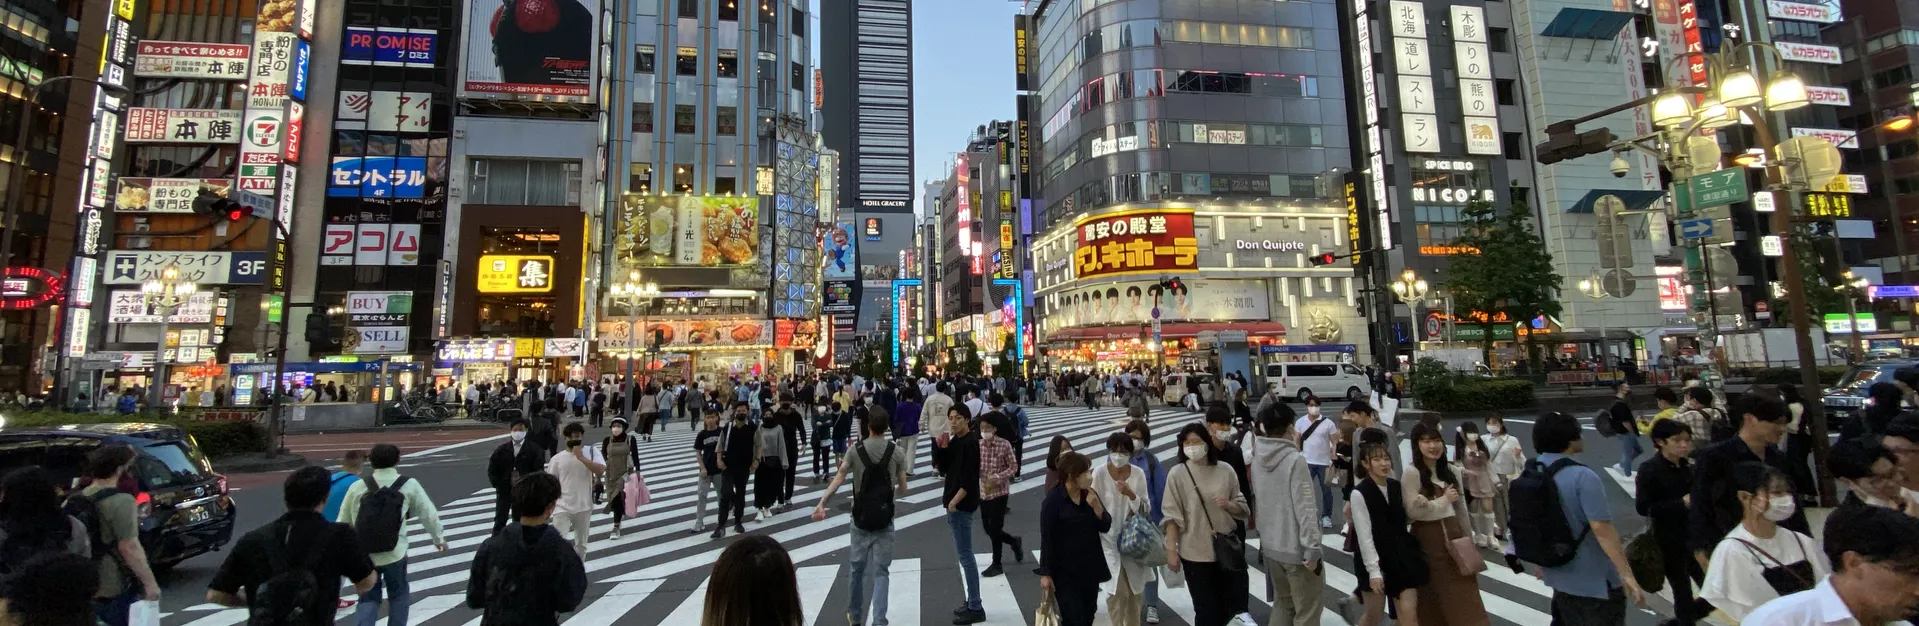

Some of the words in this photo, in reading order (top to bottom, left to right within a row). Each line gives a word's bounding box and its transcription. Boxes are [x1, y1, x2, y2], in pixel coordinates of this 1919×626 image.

[1789, 6, 1823, 18] カラオケ
[351, 34, 432, 51] PROMISE
[257, 40, 274, 77] 専門店
[274, 36, 290, 72] 粉もの
[397, 50, 429, 60] プロミス
[1797, 48, 1831, 59] カラオケ
[207, 60, 245, 75] 本陣
[1461, 11, 1485, 112] 木彫りの熊の
[1361, 42, 1375, 122] KIBORI
[1401, 5, 1428, 147] 北海道レストラン
[252, 82, 287, 97] 本陣
[1806, 90, 1840, 102] カラオケ
[253, 98, 284, 107] HONJIN
[174, 119, 233, 140] 本陣
[288, 124, 298, 152] アコム
[1471, 140, 1496, 148] KIBORI
[247, 153, 278, 163] たばこ
[1425, 160, 1451, 170] SPICE
[242, 178, 275, 189] ATM
[332, 167, 425, 187] セントラル
[1700, 172, 1736, 188] モア
[155, 187, 192, 199] 粉もの
[154, 199, 190, 210] 専門店
[685, 230, 694, 240] 光
[1085, 215, 1167, 242] 驚安の殿堂
[326, 230, 418, 253] アコム
[1236, 239, 1259, 250] Don
[1262, 239, 1304, 252] Quijote
[140, 253, 222, 266] メンズライフ
[330, 256, 345, 264] 3F
[1002, 249, 1013, 277] CASINO
[237, 260, 265, 275] 3F
[518, 260, 548, 287] 集
[139, 270, 206, 282] クリック
[116, 293, 144, 304] 大衆
[352, 298, 385, 309] BUY
[1223, 297, 1255, 308] 水潤肌
[115, 305, 143, 315] 酒場
[363, 330, 404, 342] SELL
[439, 346, 494, 360] じゃんぱら
